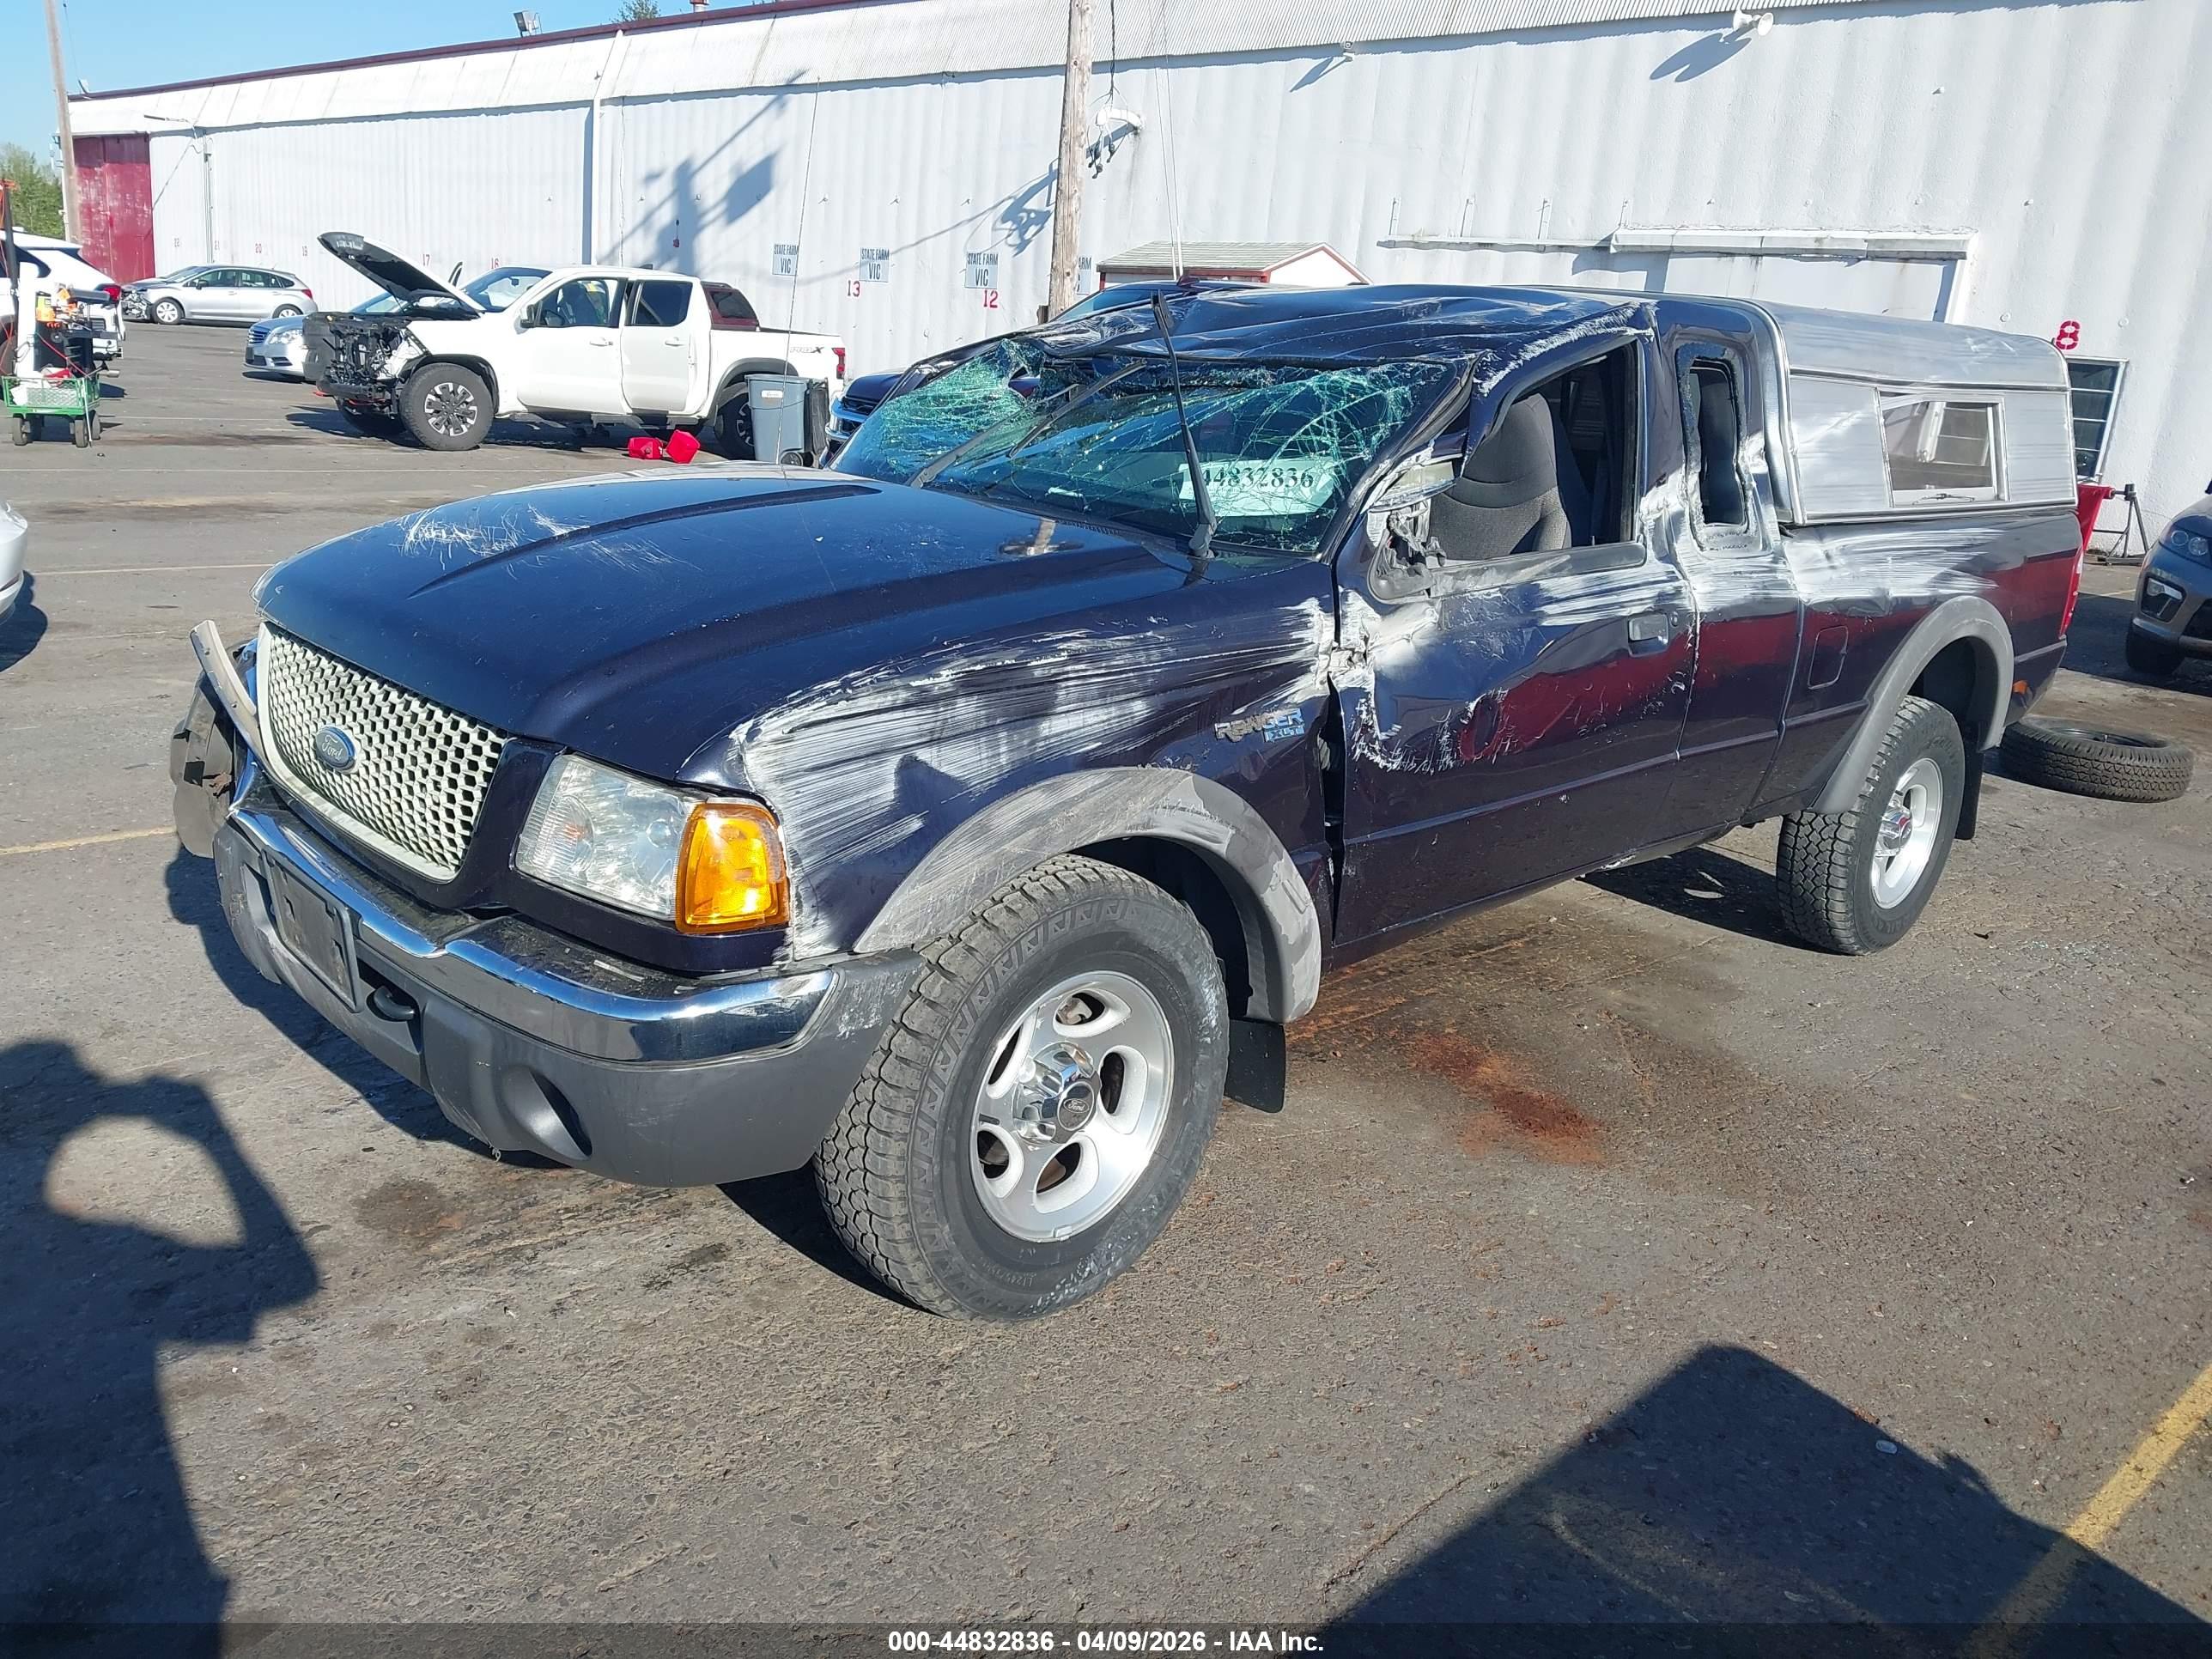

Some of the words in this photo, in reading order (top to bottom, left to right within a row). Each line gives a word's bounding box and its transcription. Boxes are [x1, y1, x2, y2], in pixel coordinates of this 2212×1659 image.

[255, 242, 262, 253] 20
[774, 244, 786, 255] STATE
[787, 245, 798, 256] FARM
[861, 248, 875, 260] STATE
[875, 249, 890, 260] FARM
[422, 253, 430, 266] 17
[781, 258, 791, 274] VIC
[967, 252, 982, 264] STATE
[982, 253, 998, 265] FARM
[1079, 257, 1091, 270] ARM
[868, 263, 881, 280] VIC
[975, 268, 988, 287] VIC
[848, 280, 860, 297] 13
[983, 289, 999, 308] 12
[2056, 320, 2080, 349] 8
[1202, 466, 1314, 489] 44832836
[322, 735, 343, 762] Ford
[1067, 1099, 1086, 1111] Ford
